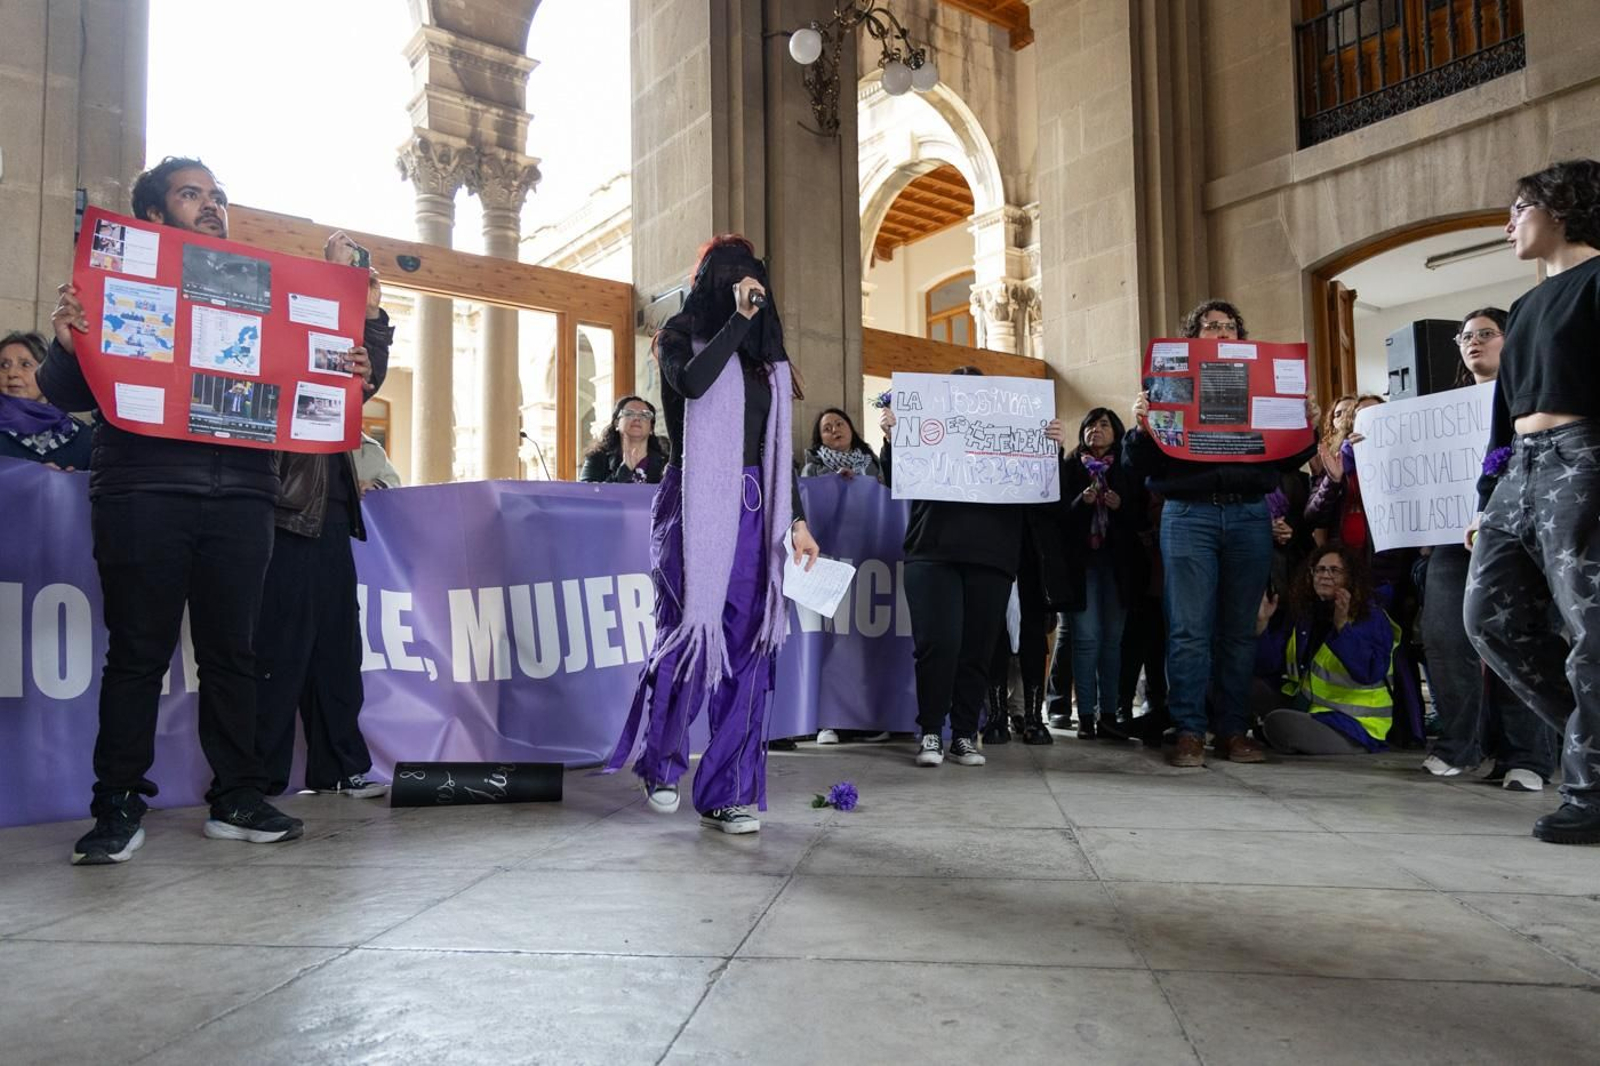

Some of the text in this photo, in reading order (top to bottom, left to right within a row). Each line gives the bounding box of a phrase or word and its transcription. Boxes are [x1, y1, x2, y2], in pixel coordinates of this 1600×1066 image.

[897, 391, 922, 411] LA
[894, 416, 945, 447] NO
[945, 415, 970, 435] ES
[1400, 404, 1456, 444] FOTOS
[1456, 401, 1479, 436] EN
[1380, 457, 1402, 492] NO
[1403, 452, 1437, 487] SON
[1396, 499, 1418, 532] TU
[1418, 494, 1475, 532] LASCIV
